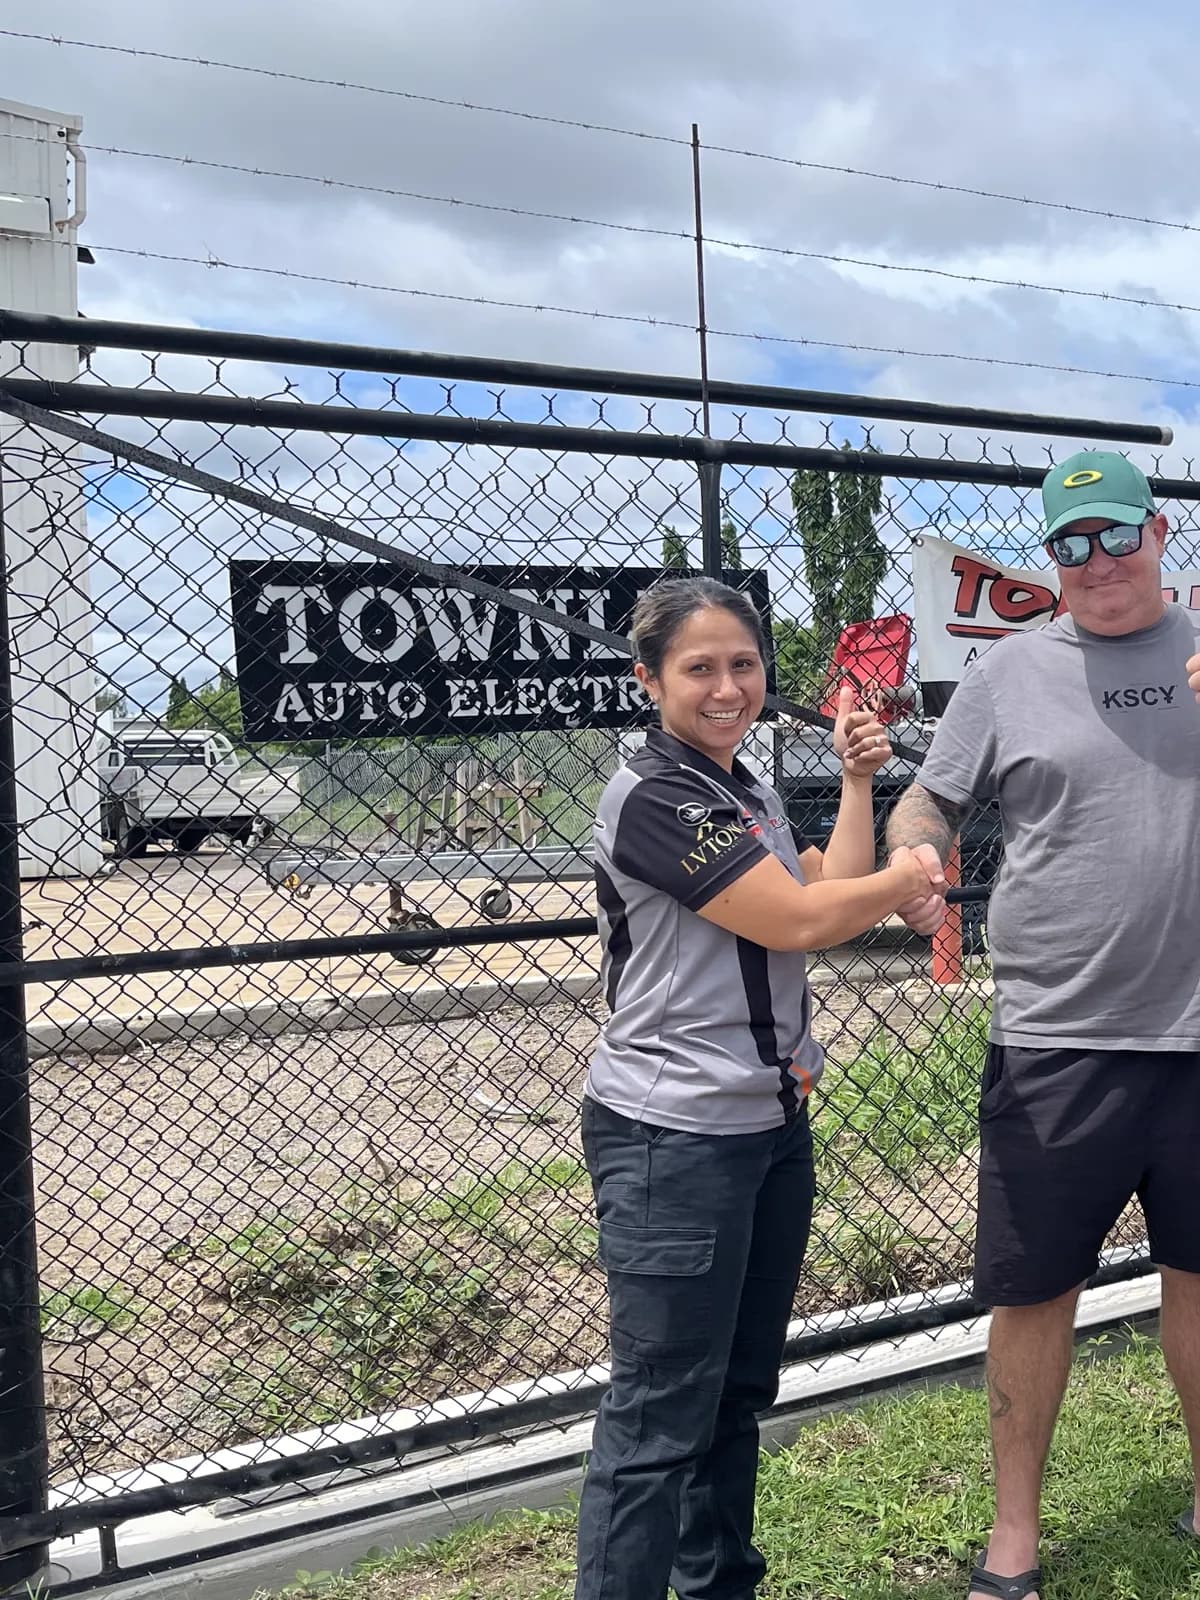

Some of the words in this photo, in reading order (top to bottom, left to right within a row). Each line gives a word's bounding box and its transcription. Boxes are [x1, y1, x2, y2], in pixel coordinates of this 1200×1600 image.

[255, 583, 756, 664] TOWNL
[271, 681, 427, 723] AUTO
[445, 675, 659, 718] ELECTR
[1102, 685, 1177, 709] KSCY
[680, 821, 747, 876] LVTON
